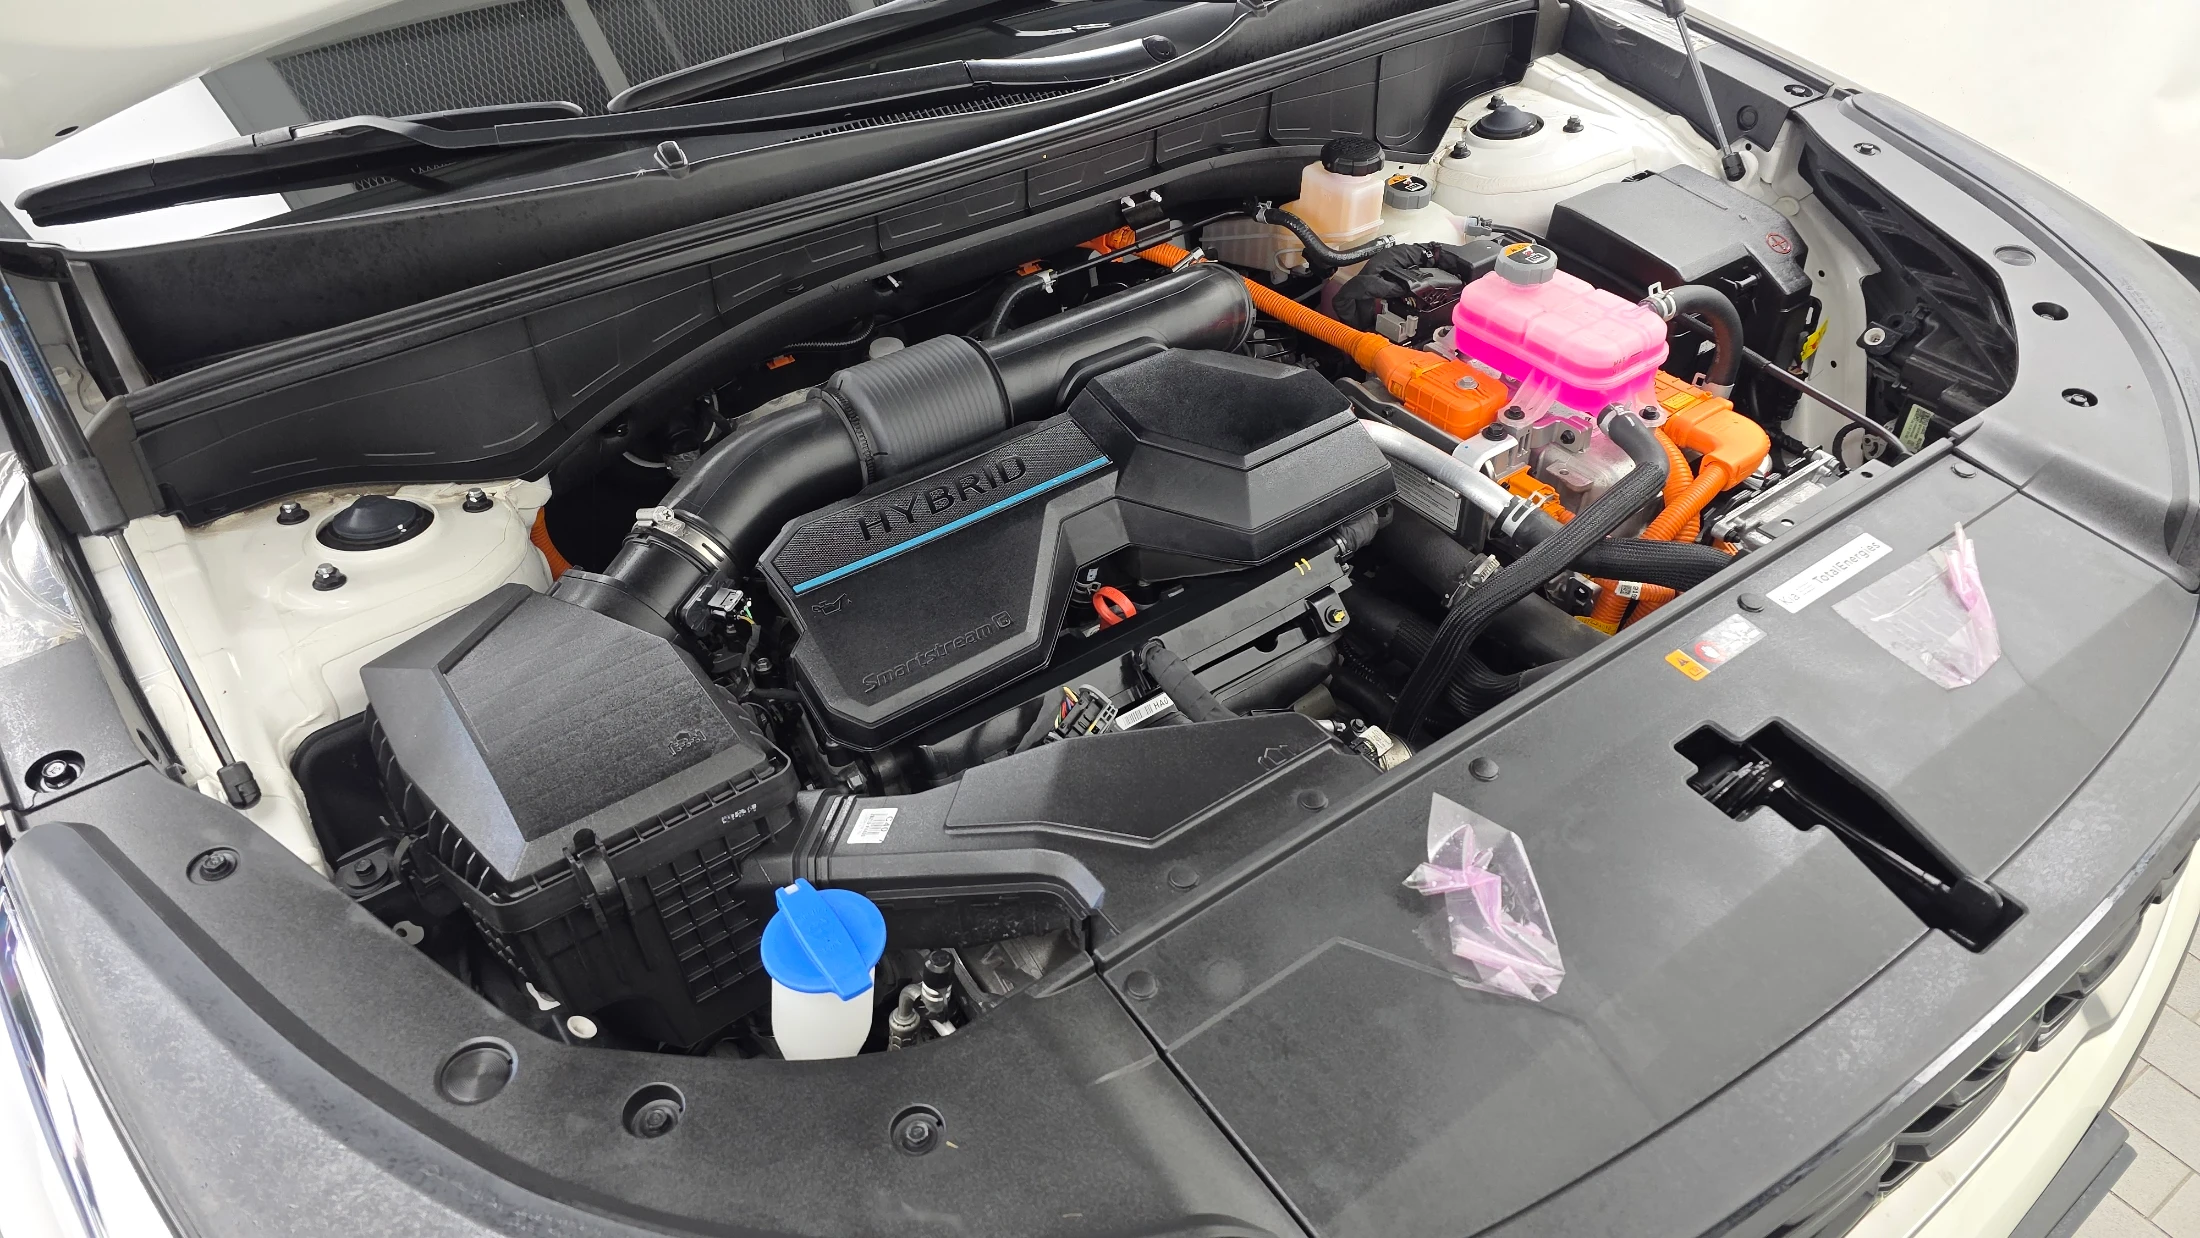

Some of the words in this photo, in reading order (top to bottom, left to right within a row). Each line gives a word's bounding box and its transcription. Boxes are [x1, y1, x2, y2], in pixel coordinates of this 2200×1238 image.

[857, 454, 1027, 541] HYBRID
[1778, 592, 1801, 606] Kia
[1811, 541, 1881, 584] TotalEnergies
[862, 622, 992, 693] Smartstream
